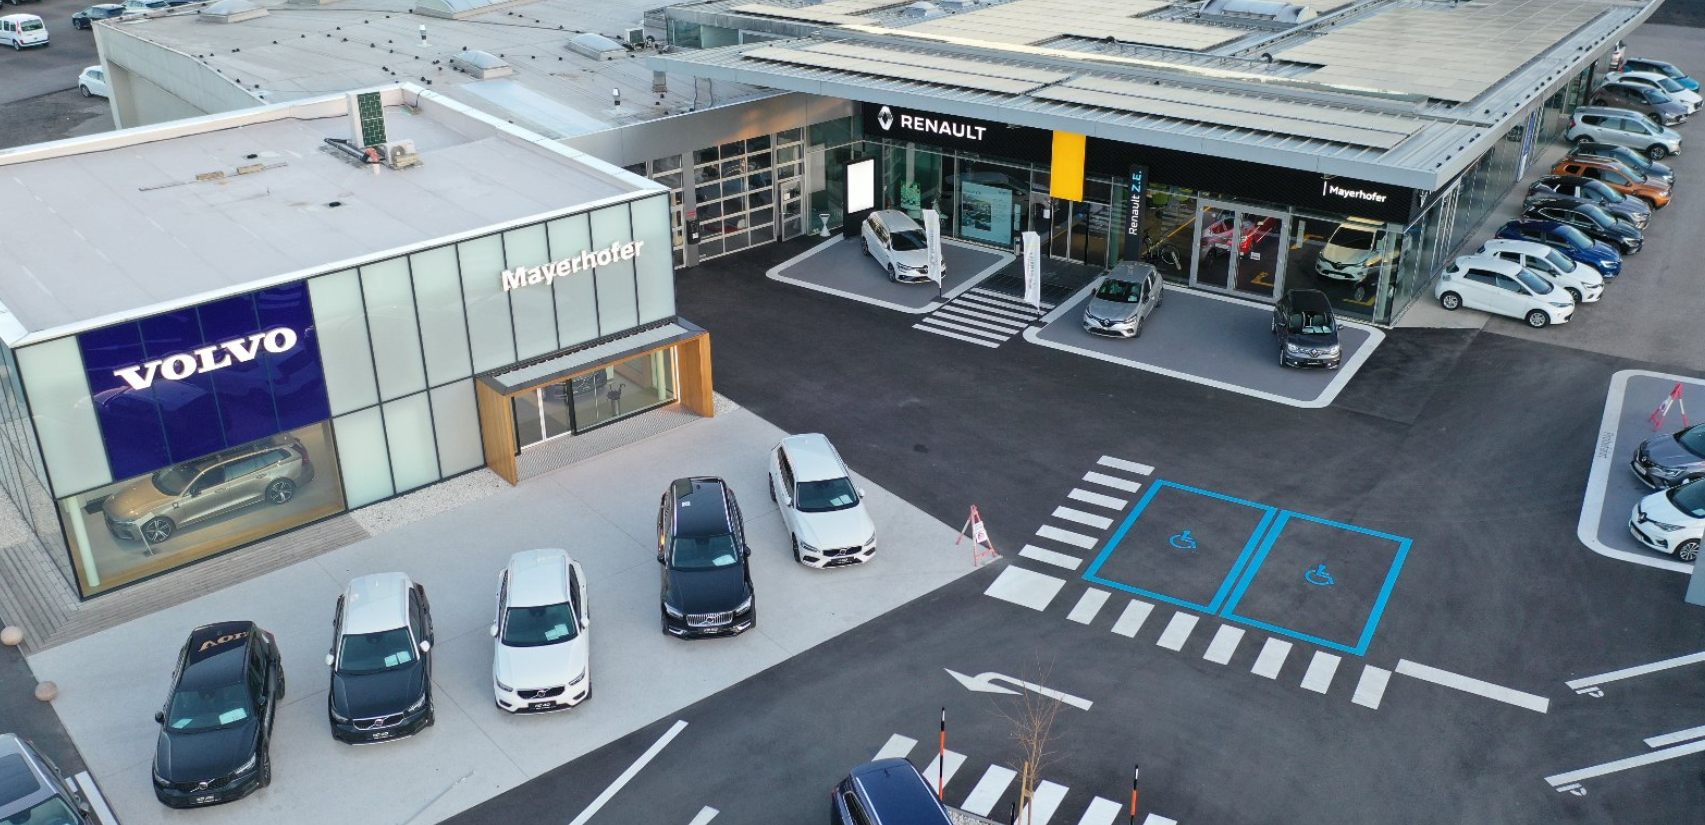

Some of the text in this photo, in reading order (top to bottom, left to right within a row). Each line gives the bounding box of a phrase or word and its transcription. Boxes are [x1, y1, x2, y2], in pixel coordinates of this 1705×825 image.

[901, 114, 987, 141] RENAULT
[1128, 170, 1143, 236] Renault Z.E.
[1329, 185, 1387, 203] Mayerhofer
[501, 240, 645, 292] Mayerhofer
[113, 327, 298, 391] VOLVO
